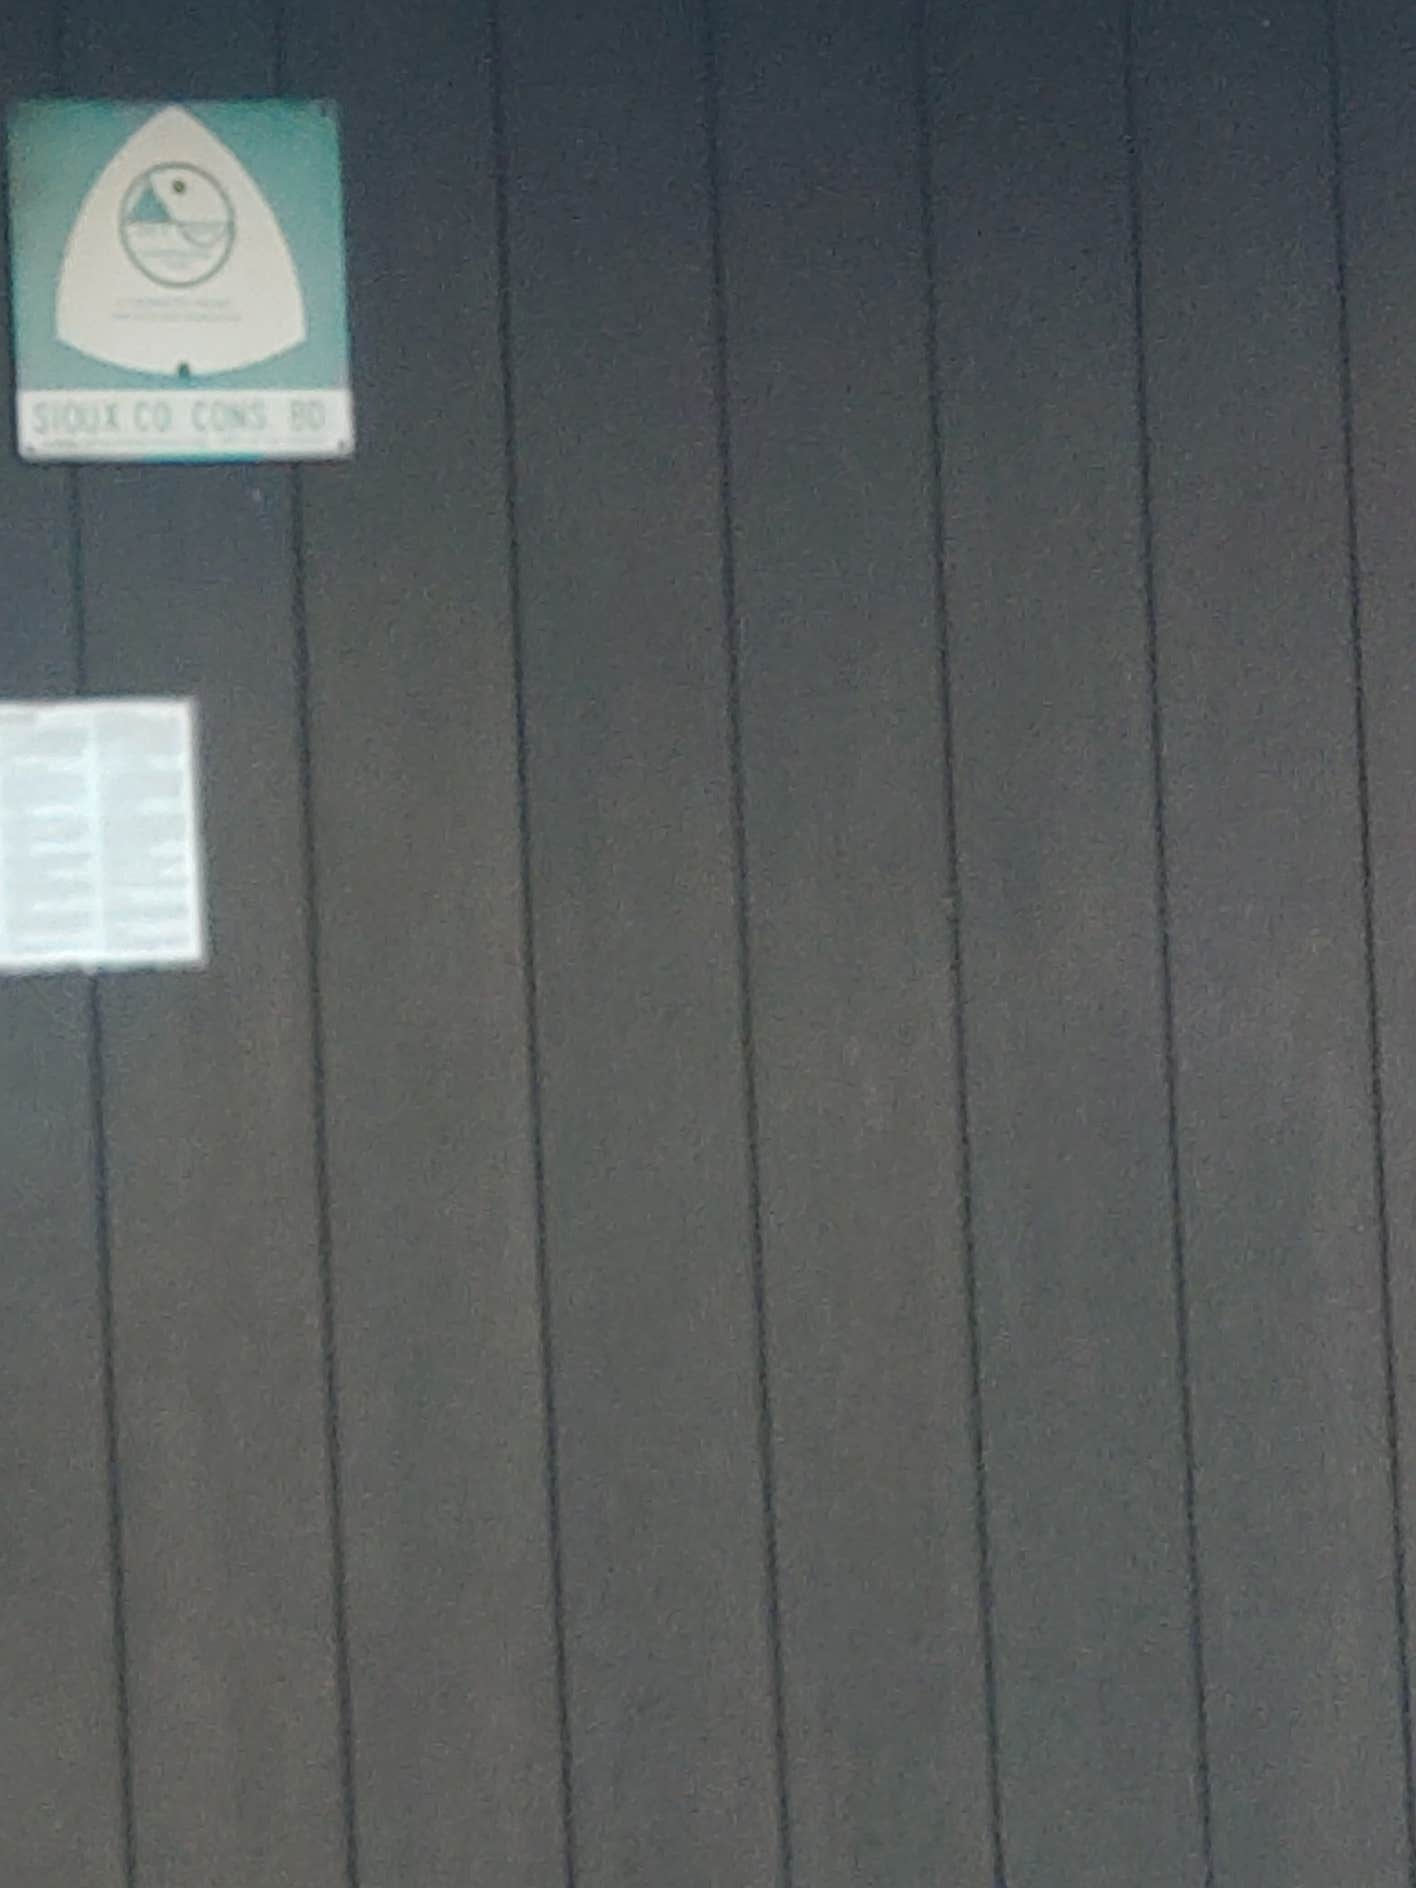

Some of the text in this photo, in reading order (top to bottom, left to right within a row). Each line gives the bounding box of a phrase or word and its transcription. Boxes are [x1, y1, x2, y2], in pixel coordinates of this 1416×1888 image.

[32, 400, 120, 435] SIOUX
[133, 400, 172, 434] CO
[191, 399, 267, 433] CONS
